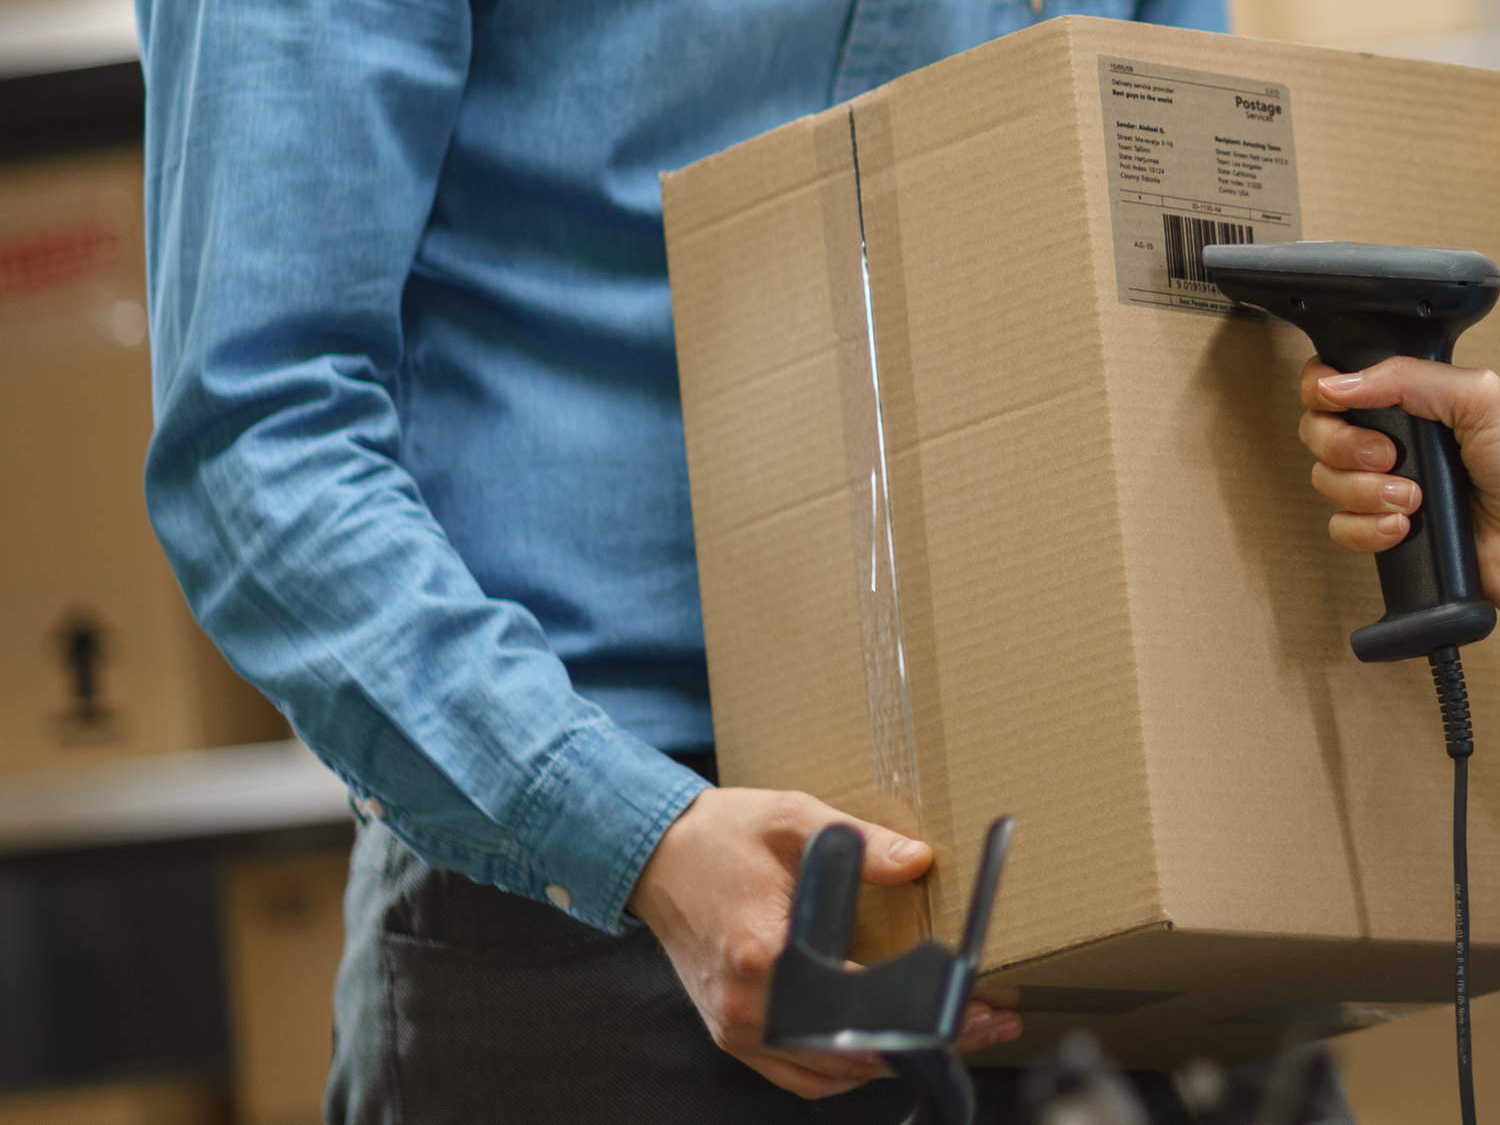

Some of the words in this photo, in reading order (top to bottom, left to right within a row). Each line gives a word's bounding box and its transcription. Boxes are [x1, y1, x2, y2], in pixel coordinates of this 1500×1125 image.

[1111, 78, 1133, 89] Delivery
[1126, 92, 1139, 100] guys
[1146, 94, 1156, 102] the
[1157, 96, 1173, 104] world
[1235, 95, 1282, 117] Postage
